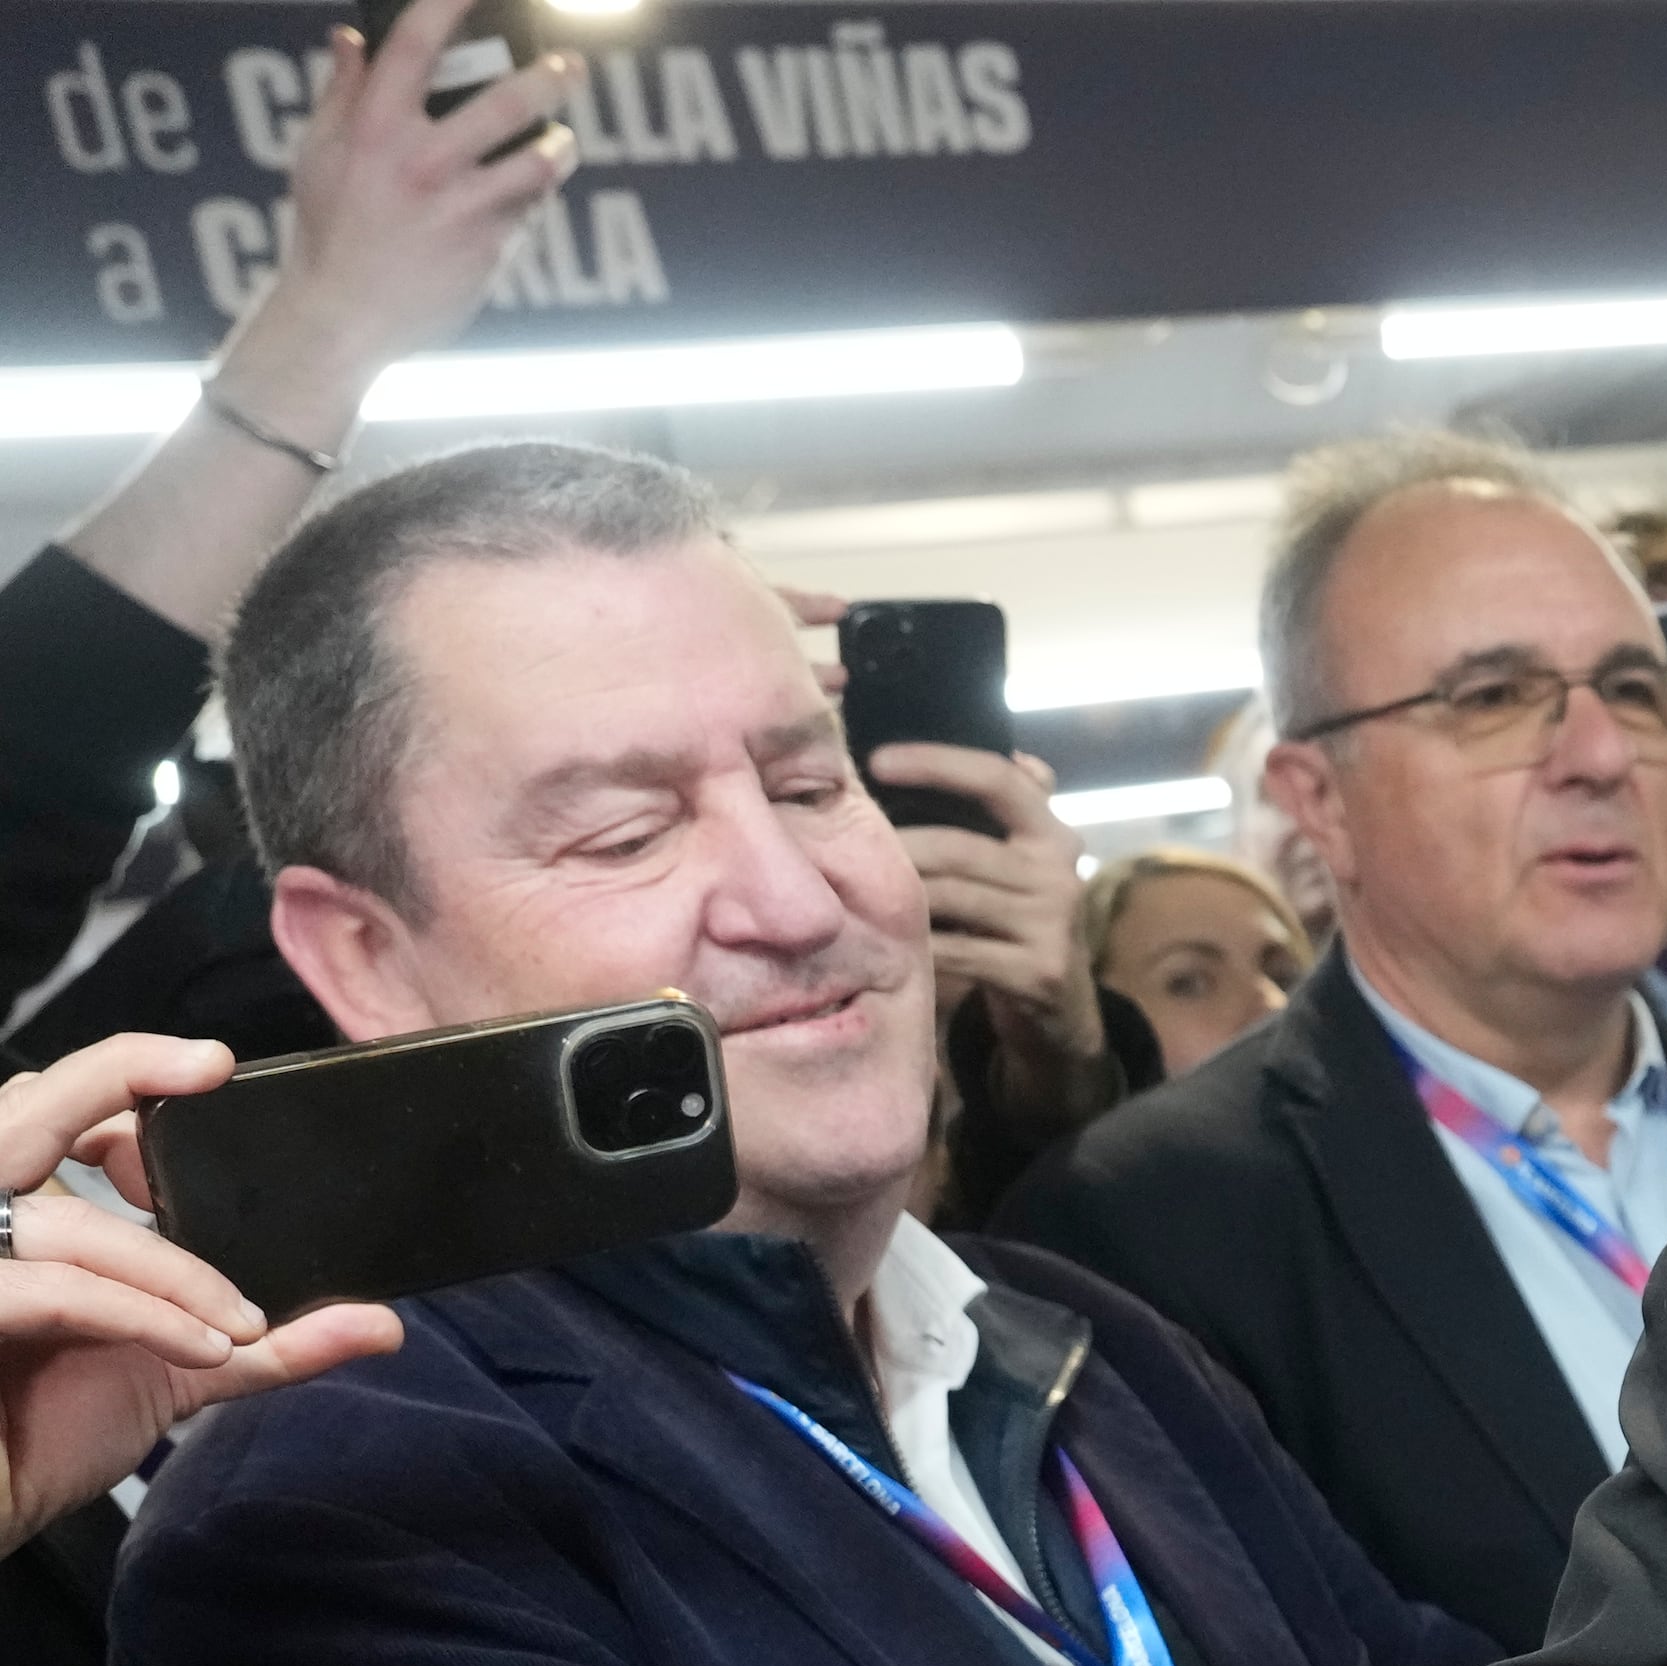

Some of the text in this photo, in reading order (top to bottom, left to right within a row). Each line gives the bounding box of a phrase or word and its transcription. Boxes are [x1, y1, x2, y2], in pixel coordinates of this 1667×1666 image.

[46, 39, 197, 172] de
[737, 24, 1032, 161] VIÑAS
[87, 221, 164, 323] a
